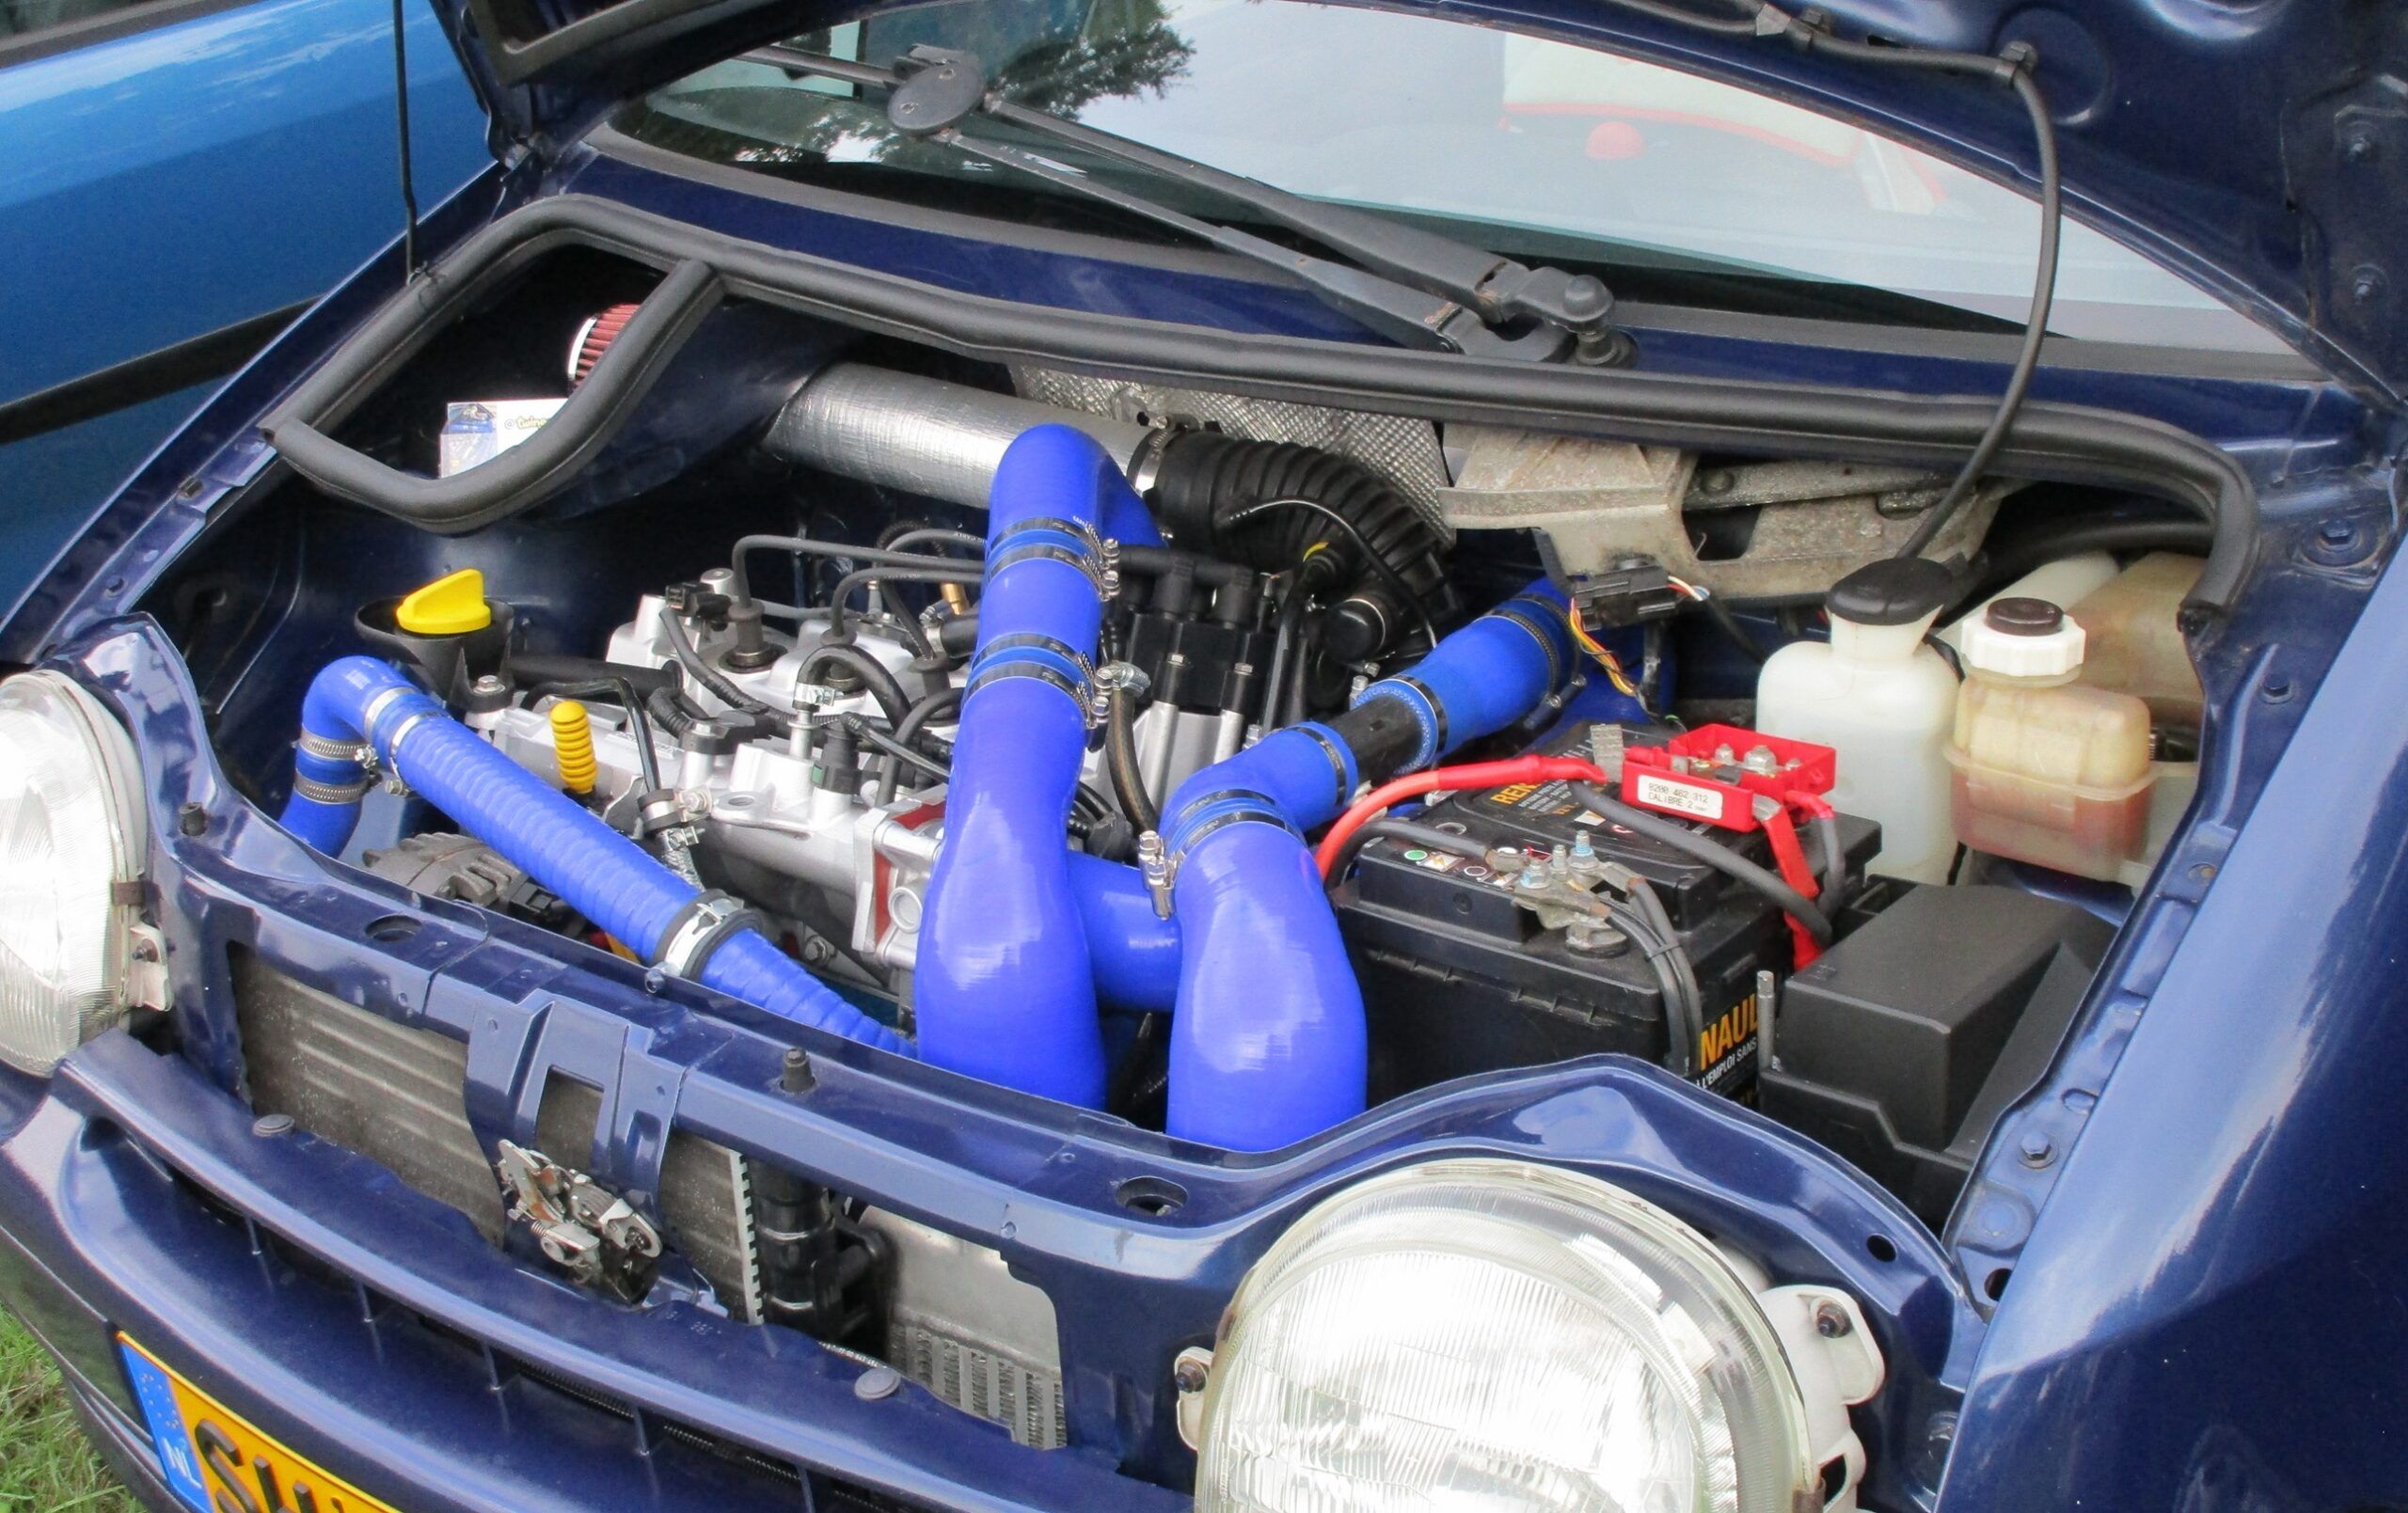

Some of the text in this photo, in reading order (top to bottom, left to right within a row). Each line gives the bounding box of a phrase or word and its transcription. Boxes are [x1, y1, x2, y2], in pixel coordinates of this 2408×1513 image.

[1648, 793, 1684, 808] CALIBRE
[1692, 793, 1709, 804] 312
[1736, 1036, 1757, 1062] SANS
[163, 1437, 203, 1489] NL
